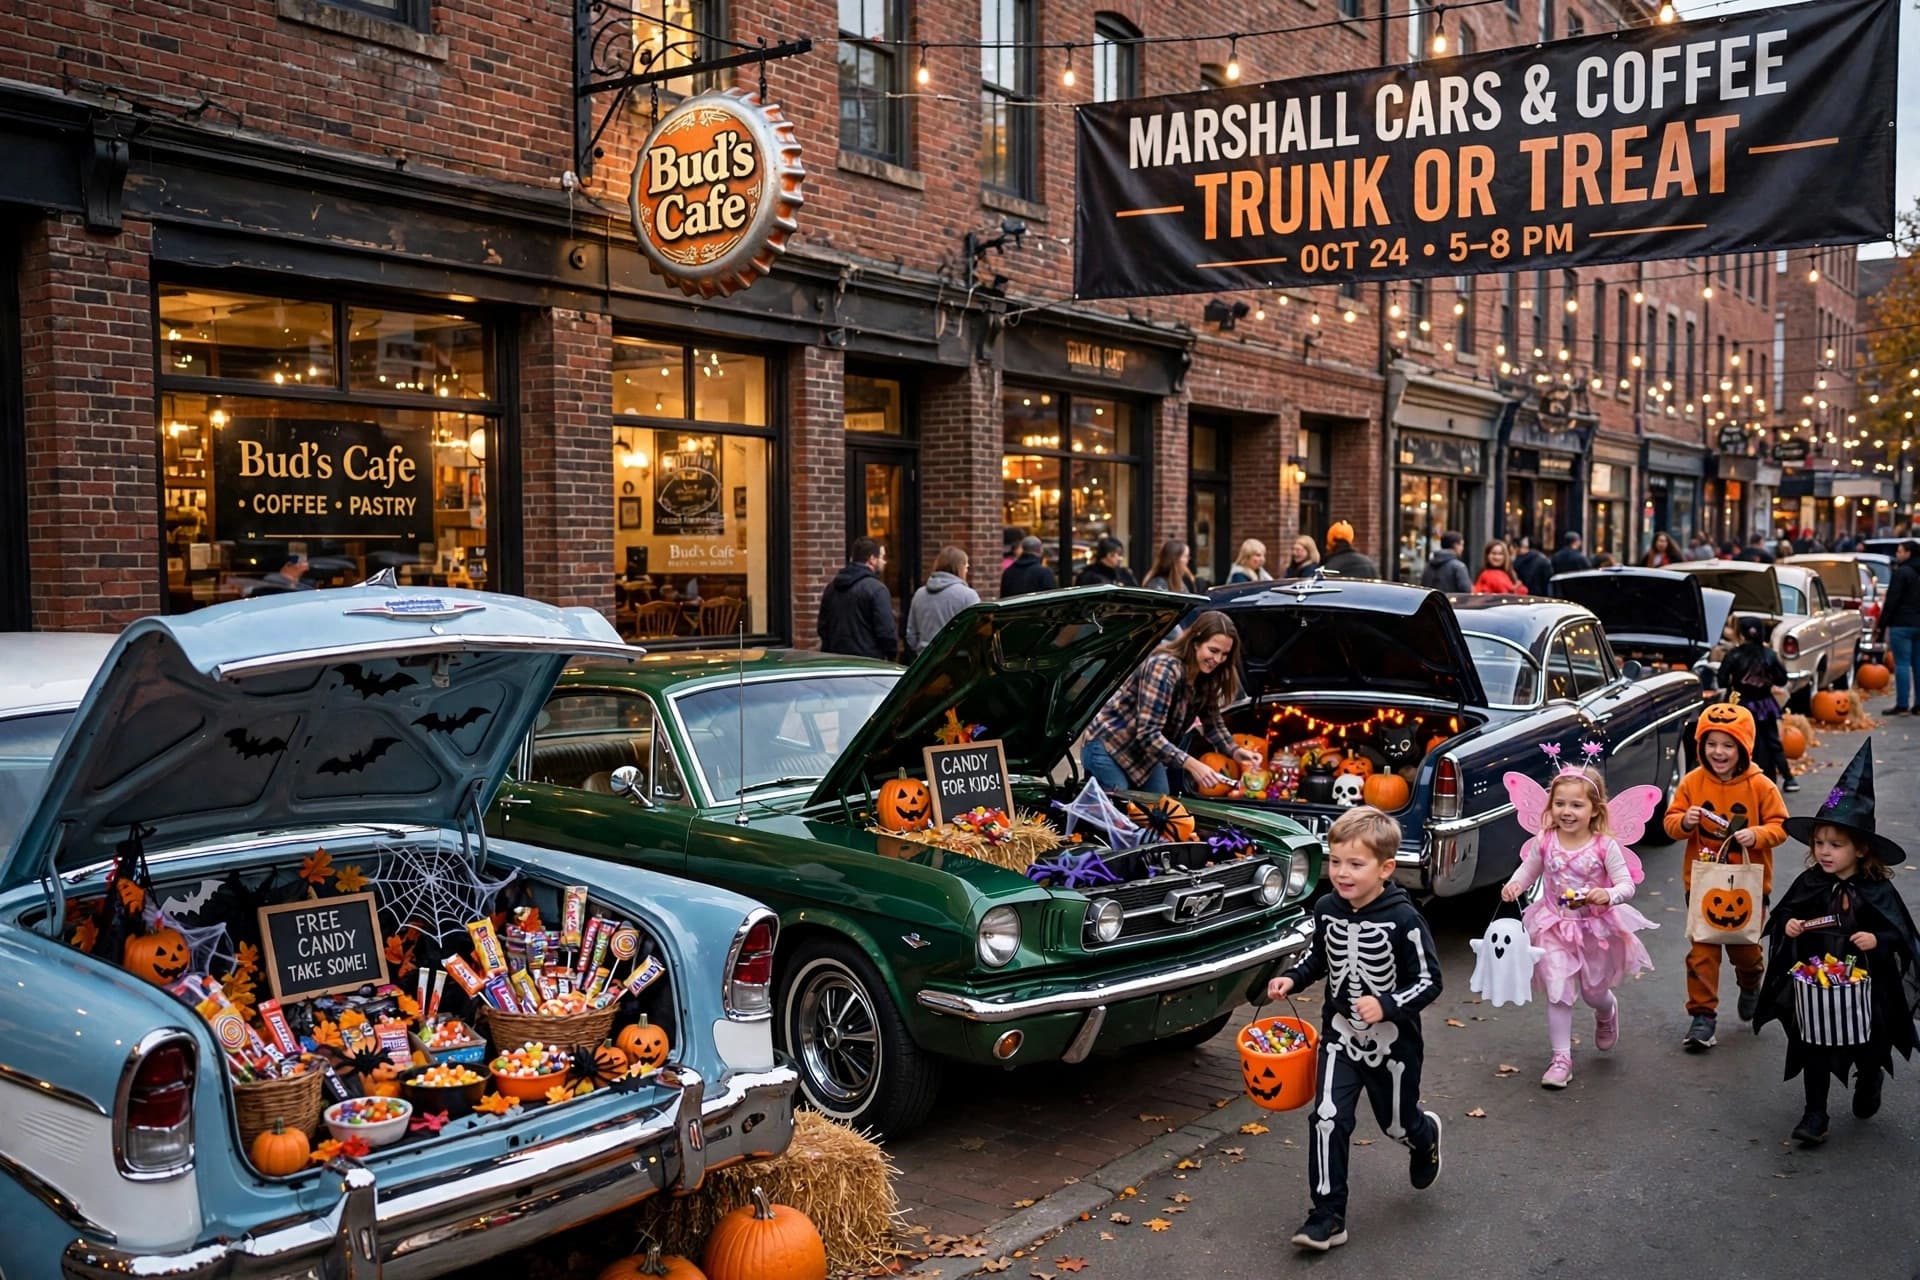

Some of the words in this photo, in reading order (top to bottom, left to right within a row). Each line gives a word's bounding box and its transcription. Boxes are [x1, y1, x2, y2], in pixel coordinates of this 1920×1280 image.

[1129, 91, 1360, 169] MARSHALL
[1375, 71, 1502, 143] CARS
[1519, 64, 1557, 125] &
[1576, 29, 1788, 118] COFFEE
[648, 131, 755, 194] Bud's
[1193, 155, 1391, 240] TRUNK
[1413, 144, 1497, 223] OR
[1519, 113, 1740, 212] TREAT
[656, 183, 746, 240] Cafe
[1300, 241, 1360, 273] OCT
[1369, 237, 1409, 269] 24
[1448, 228, 1511, 262] 5–8
[1522, 222, 1574, 256] PM
[238, 440, 332, 480] Bud's
[343, 445, 416, 489] Cafe
[252, 493, 328, 515] COFFEE
[350, 495, 417, 517] PASTRY
[941, 753, 988, 775] CANDY
[941, 778, 967, 796] FOR
[968, 772, 1001, 792] KIDS!
[295, 910, 341, 934] FREE
[298, 929, 356, 958] CANDY
[287, 961, 323, 982] TAKE
[327, 953, 368, 975] SOME!
